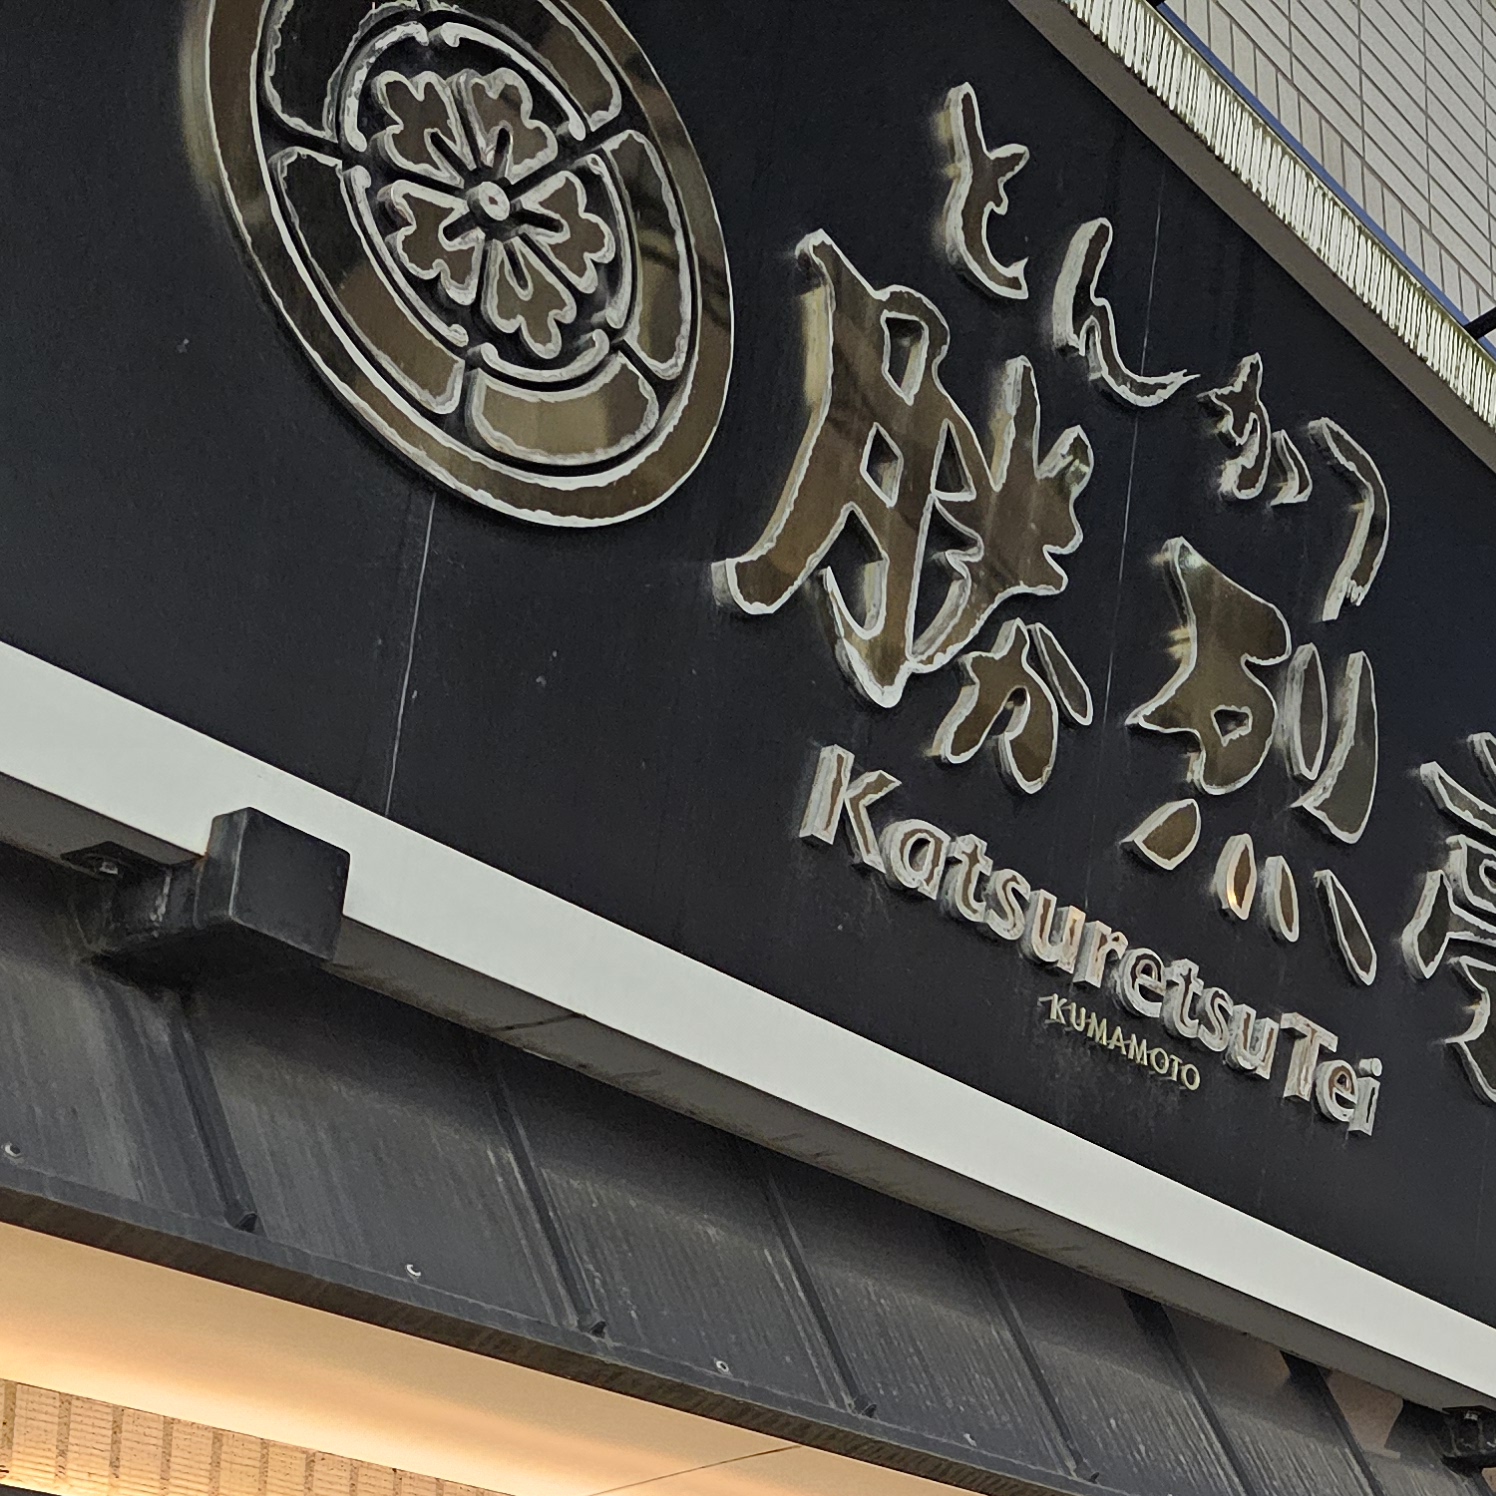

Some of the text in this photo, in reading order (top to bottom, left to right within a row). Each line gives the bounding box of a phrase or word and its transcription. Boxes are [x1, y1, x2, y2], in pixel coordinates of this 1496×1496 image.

[943, 83, 1390, 621] とんかつ
[1048, 993, 1201, 1091] KUMAMOTO
